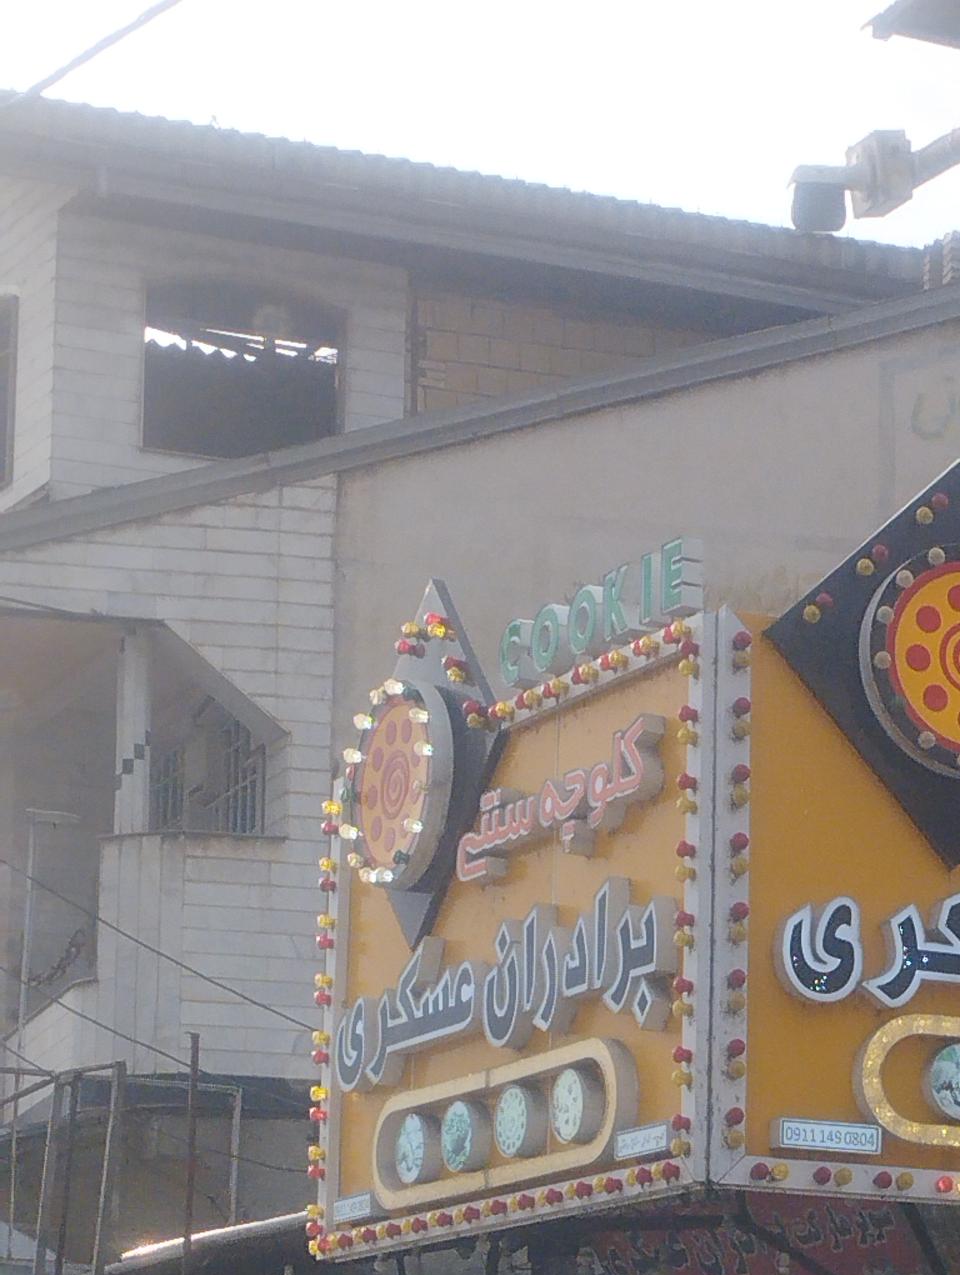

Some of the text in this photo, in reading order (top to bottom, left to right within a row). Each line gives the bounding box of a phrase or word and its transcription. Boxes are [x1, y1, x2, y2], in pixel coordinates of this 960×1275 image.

[500, 536, 688, 688] COOKIE
[456, 716, 644, 882] کلوچه سنتی
[334, 876, 660, 1092] برادران عسکری
